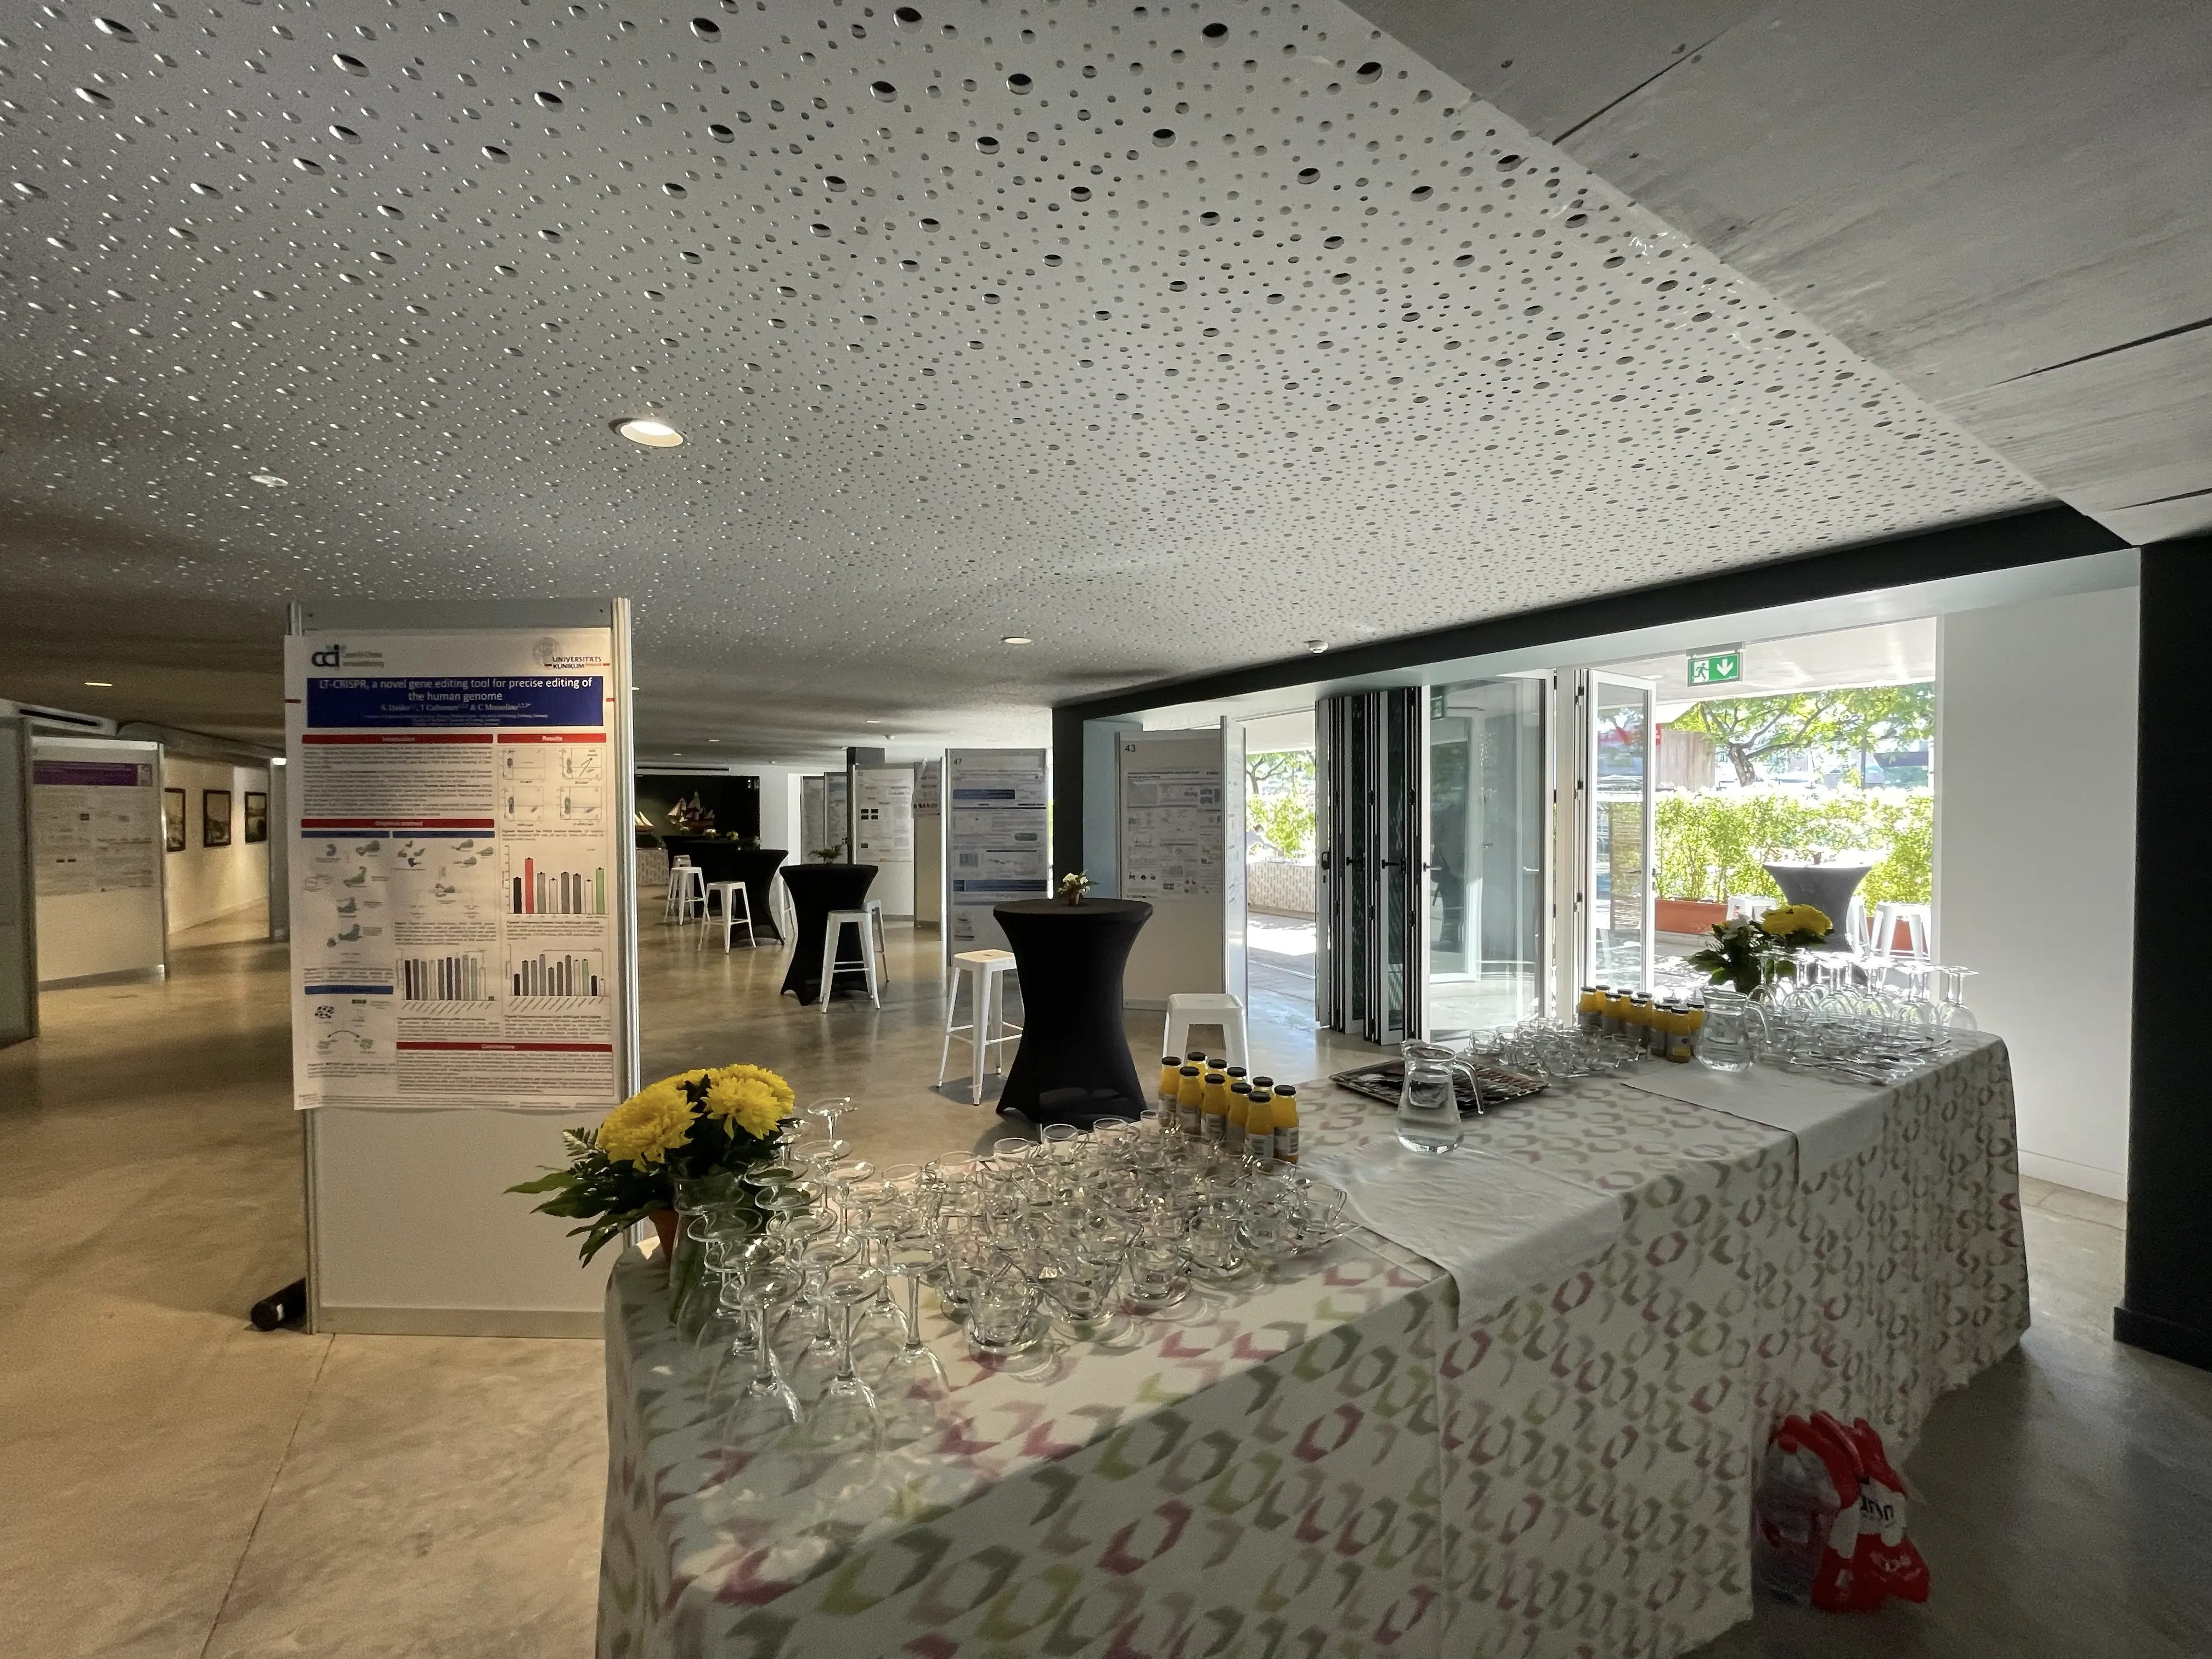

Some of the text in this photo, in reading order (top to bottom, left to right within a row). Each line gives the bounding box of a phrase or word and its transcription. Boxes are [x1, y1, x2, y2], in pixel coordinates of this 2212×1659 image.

[380, 679, 407, 688] novel
[409, 680, 433, 690] gene
[435, 679, 469, 690] editing
[471, 678, 490, 687] tool
[492, 678, 505, 687] for
[509, 678, 543, 689] precise
[546, 677, 579, 689] editing
[582, 677, 593, 687] of
[408, 692, 503, 702] the human genome
[1125, 744, 1136, 752] 43
